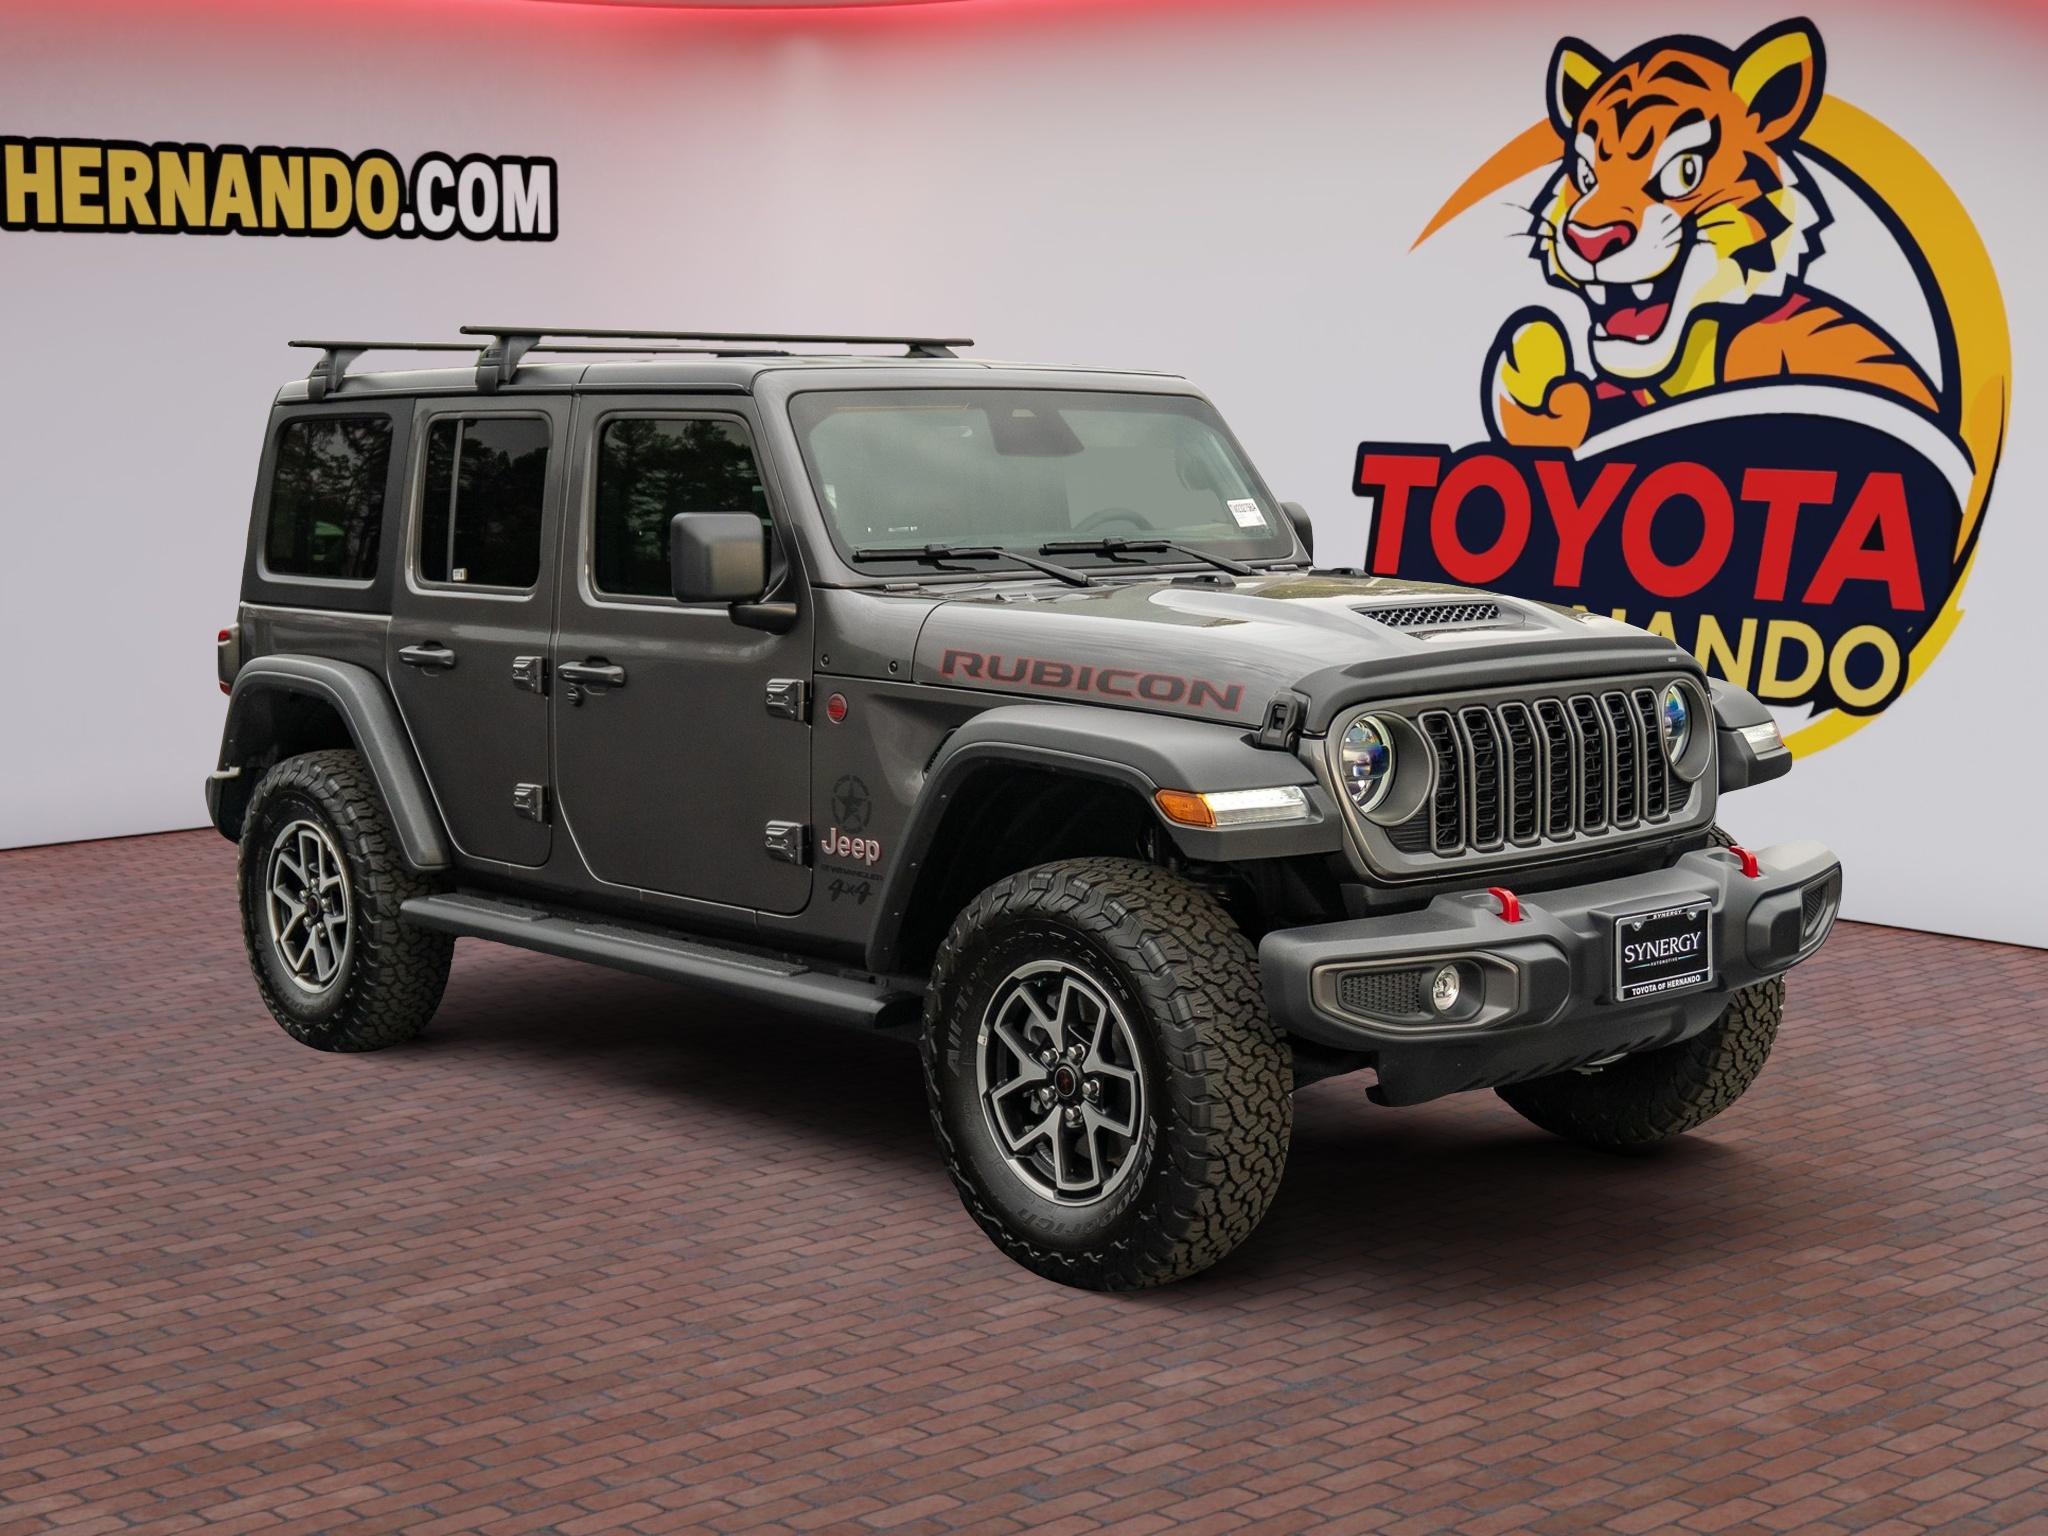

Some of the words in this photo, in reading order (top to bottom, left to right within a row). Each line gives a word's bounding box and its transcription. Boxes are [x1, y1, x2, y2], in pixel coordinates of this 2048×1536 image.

[4, 144, 551, 234] HERNANDO.COM
[1360, 453, 1925, 612] TOYOTA
[939, 649, 1245, 712] RUBICON
[821, 827, 881, 866] Jeep
[1624, 931, 1701, 963] SYNERGY
[1632, 985, 1657, 996] TOYOTA
[1658, 983, 1666, 991] OF
[1667, 974, 1701, 989] HERNANDO
